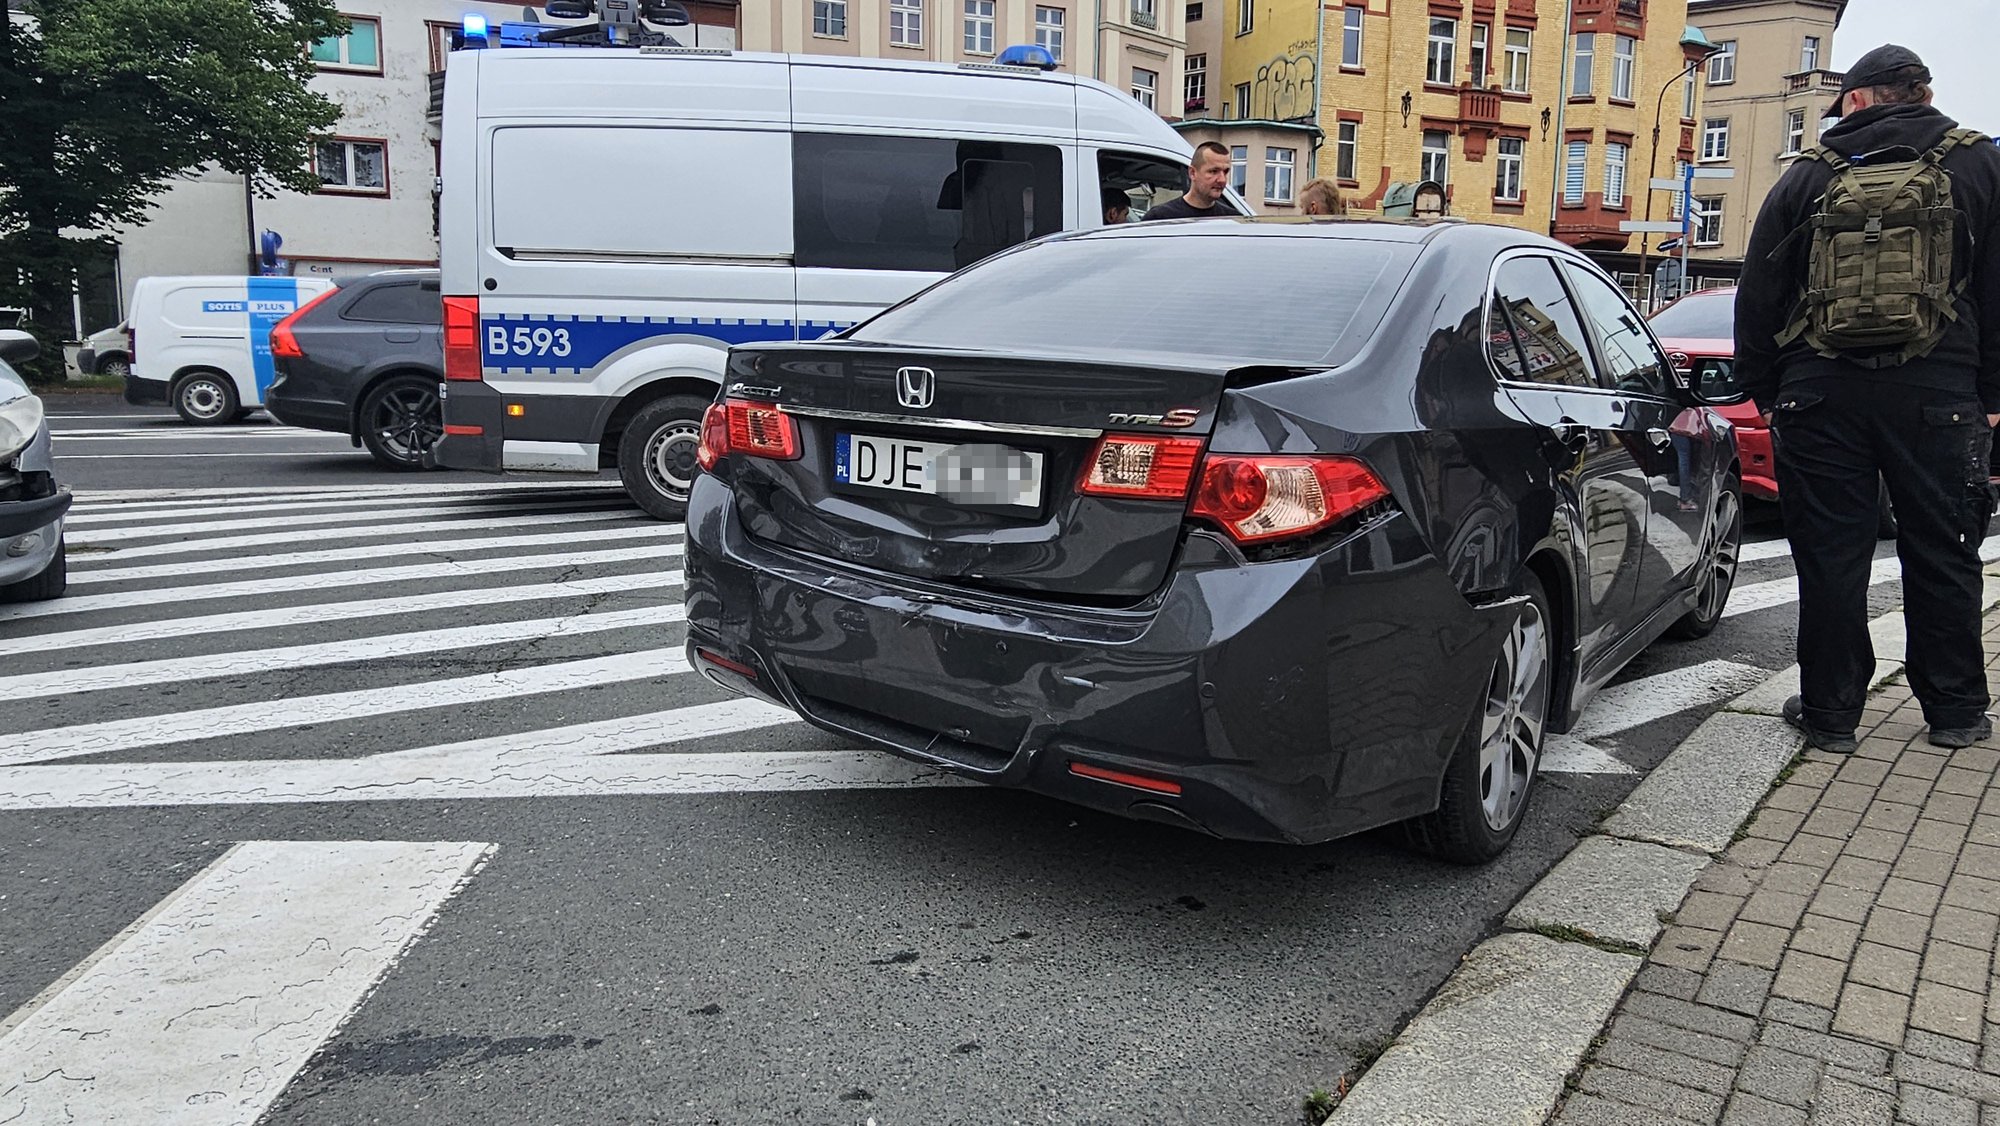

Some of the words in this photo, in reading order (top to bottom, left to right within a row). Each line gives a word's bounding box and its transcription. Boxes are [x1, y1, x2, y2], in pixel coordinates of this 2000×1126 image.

[207, 302, 242, 311] SOTIS
[256, 303, 285, 311] PLUS
[488, 326, 572, 357] B593
[1108, 413, 1164, 425] TYPE
[1161, 408, 1200, 427] S
[836, 464, 849, 477] PL
[857, 440, 924, 490] DJE
